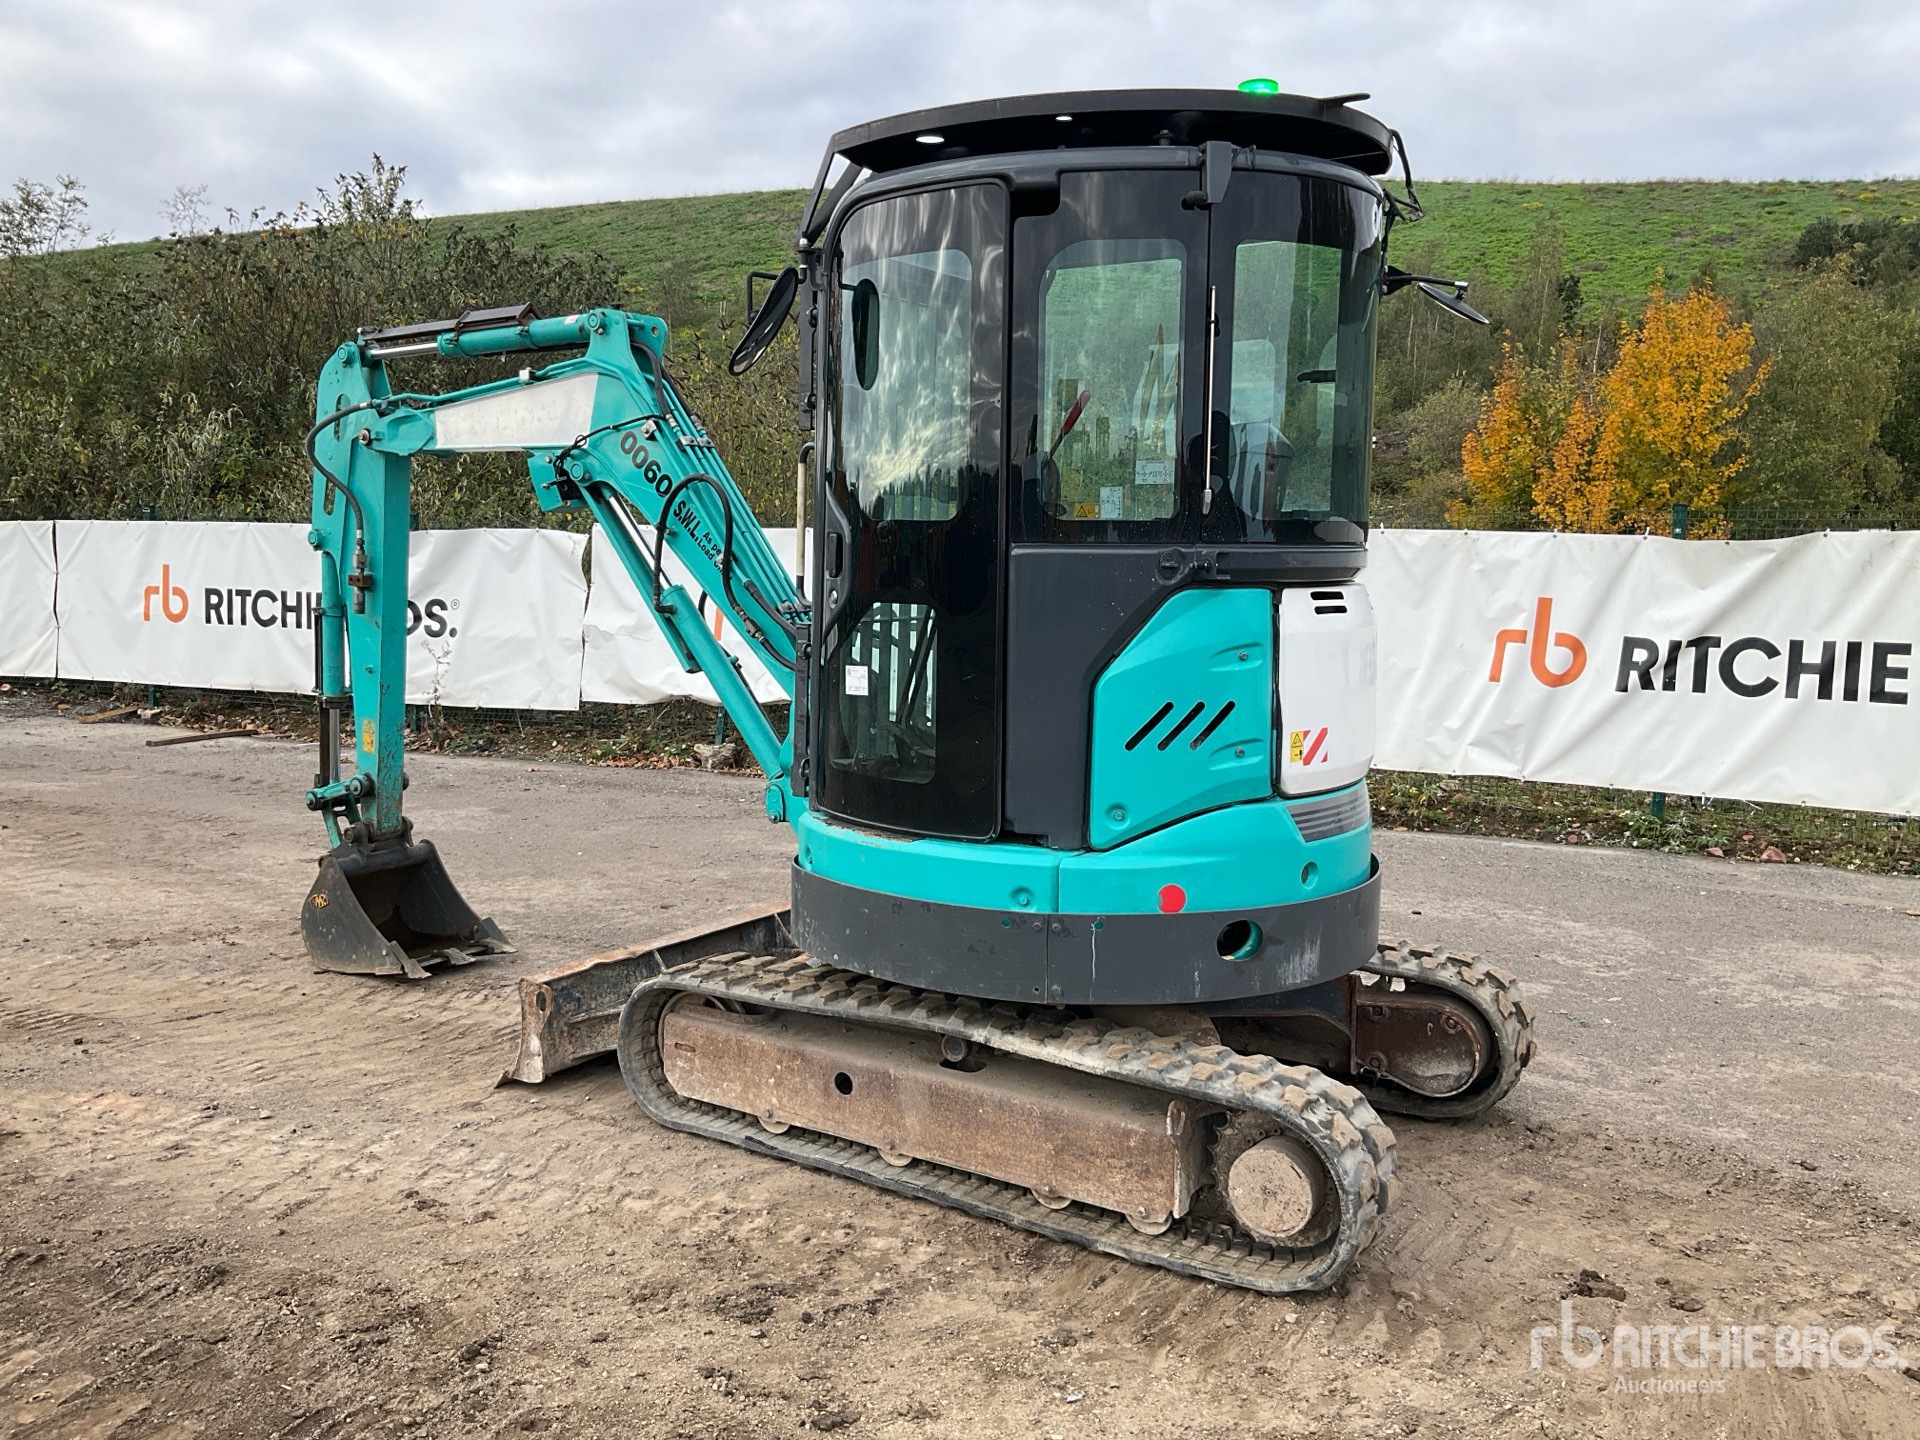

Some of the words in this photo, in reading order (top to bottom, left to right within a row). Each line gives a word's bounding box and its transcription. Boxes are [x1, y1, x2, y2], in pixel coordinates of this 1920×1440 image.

[621, 431, 673, 498] 0060
[698, 538, 715, 561] Load
[703, 531, 718, 544] As
[711, 543, 722, 556] pe
[204, 587, 323, 630] RITCHI
[1615, 635, 1913, 705] RITCHIE
